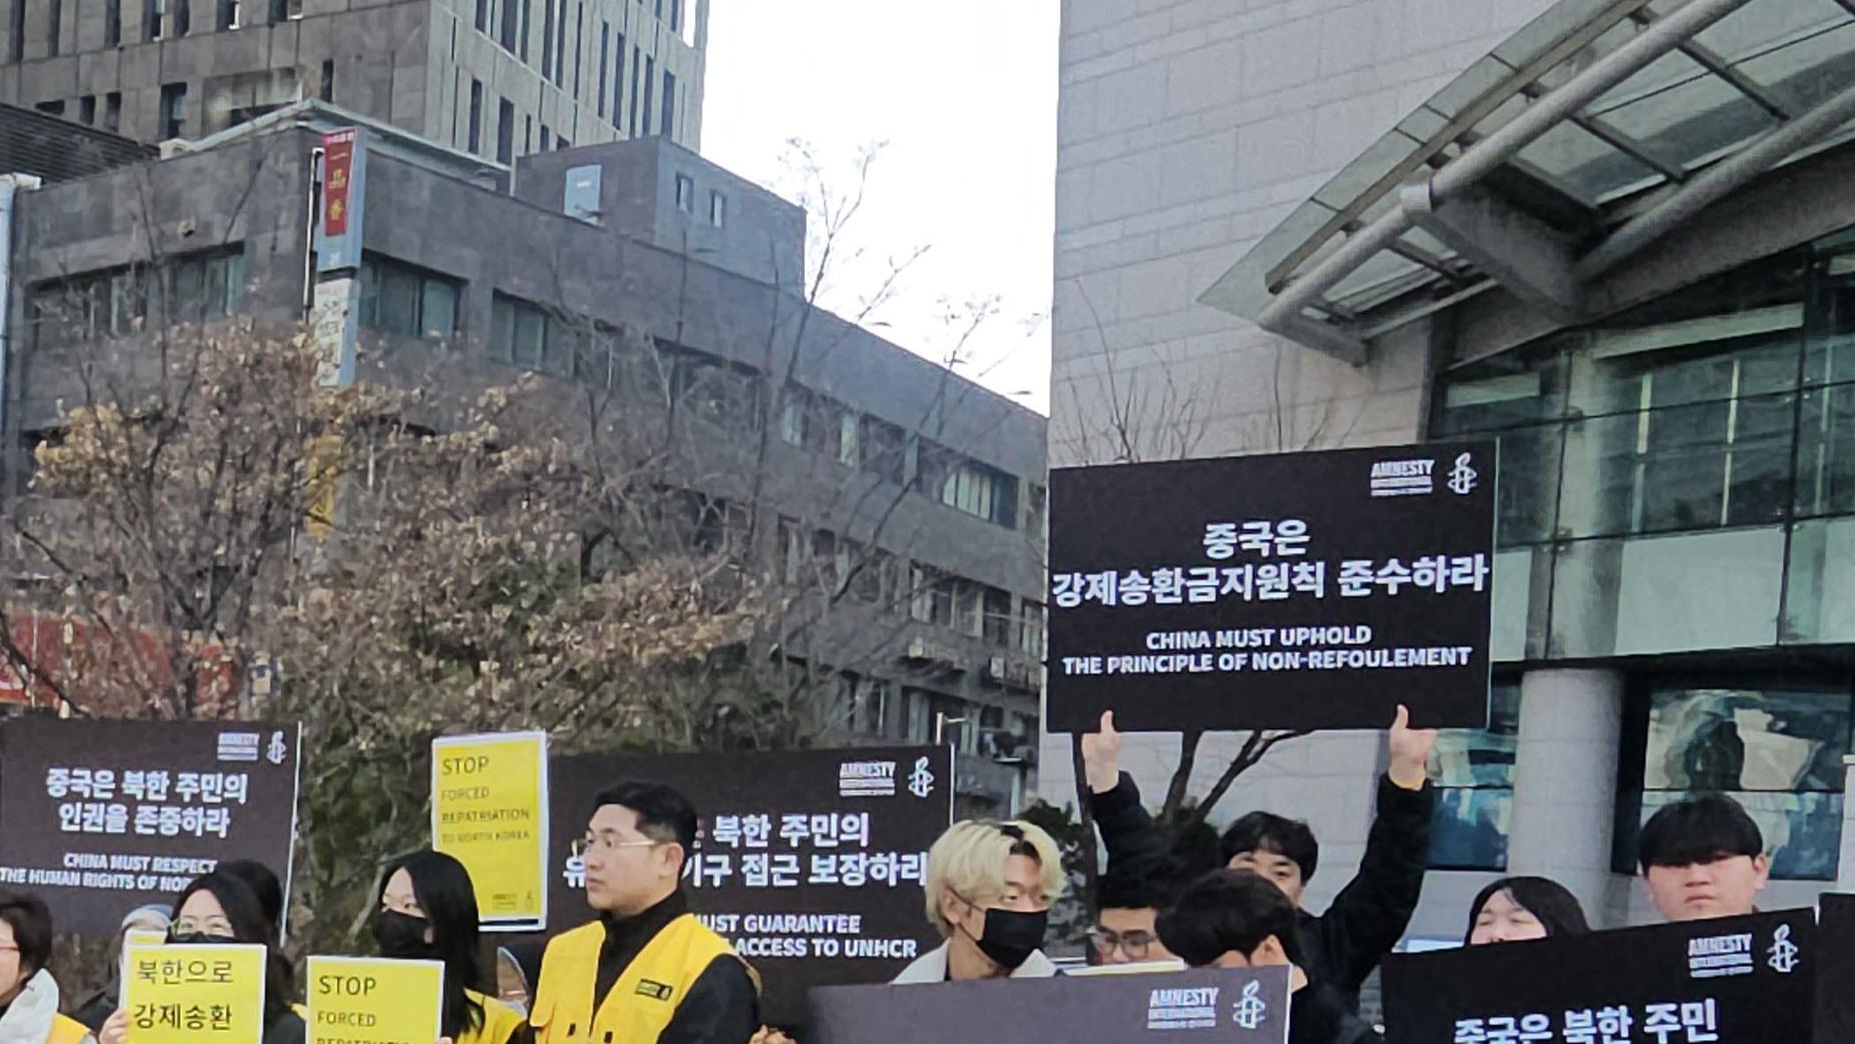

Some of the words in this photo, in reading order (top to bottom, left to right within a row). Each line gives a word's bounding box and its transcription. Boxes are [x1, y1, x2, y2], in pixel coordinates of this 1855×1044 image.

[1203, 518, 1311, 560] 중국은
[1051, 561, 1326, 608] 강제송환금지원칙
[1337, 553, 1490, 595] 준수하라
[1146, 629, 1211, 651] CHINA
[1215, 628, 1275, 649] MUST
[1279, 625, 1373, 647] UPHOLD
[1062, 656, 1103, 676] THE
[1108, 654, 1214, 674] PRINCIPLE
[1219, 652, 1249, 672] OF
[1252, 646, 1473, 672] NON-REFOULEMENT
[442, 755, 490, 776] STOP
[46, 768, 116, 799] 중국은
[122, 769, 170, 801] 북한
[175, 773, 248, 805] 주민의
[441, 786, 490, 801] FORCED
[59, 802, 129, 833] 인권을
[135, 805, 231, 838] 존중하라
[441, 808, 530, 825] REPATRIATION
[713, 814, 771, 848] 북한
[779, 812, 871, 848] 주민의
[63, 853, 108, 870] CHINA
[110, 855, 150, 872] MUST
[152, 856, 218, 874] RESPECT
[741, 852, 801, 888] 접근
[0, 867, 26, 883] THE
[29, 868, 81, 886] HUMAN
[83, 871, 135, 889] RIGHTS
[137, 873, 158, 890] OF
[744, 914, 862, 934] GUARANTEE
[736, 938, 806, 957] ACCESS
[812, 939, 838, 957] TO
[845, 940, 917, 958] UNHCR
[136, 959, 235, 986] 북한으로
[319, 974, 377, 996] STOP
[1150, 987, 1220, 1008] AMNESTY
[133, 1003, 233, 1031] 강제송환
[317, 1009, 376, 1028] FORCED
[1643, 998, 1719, 1044] 주민
